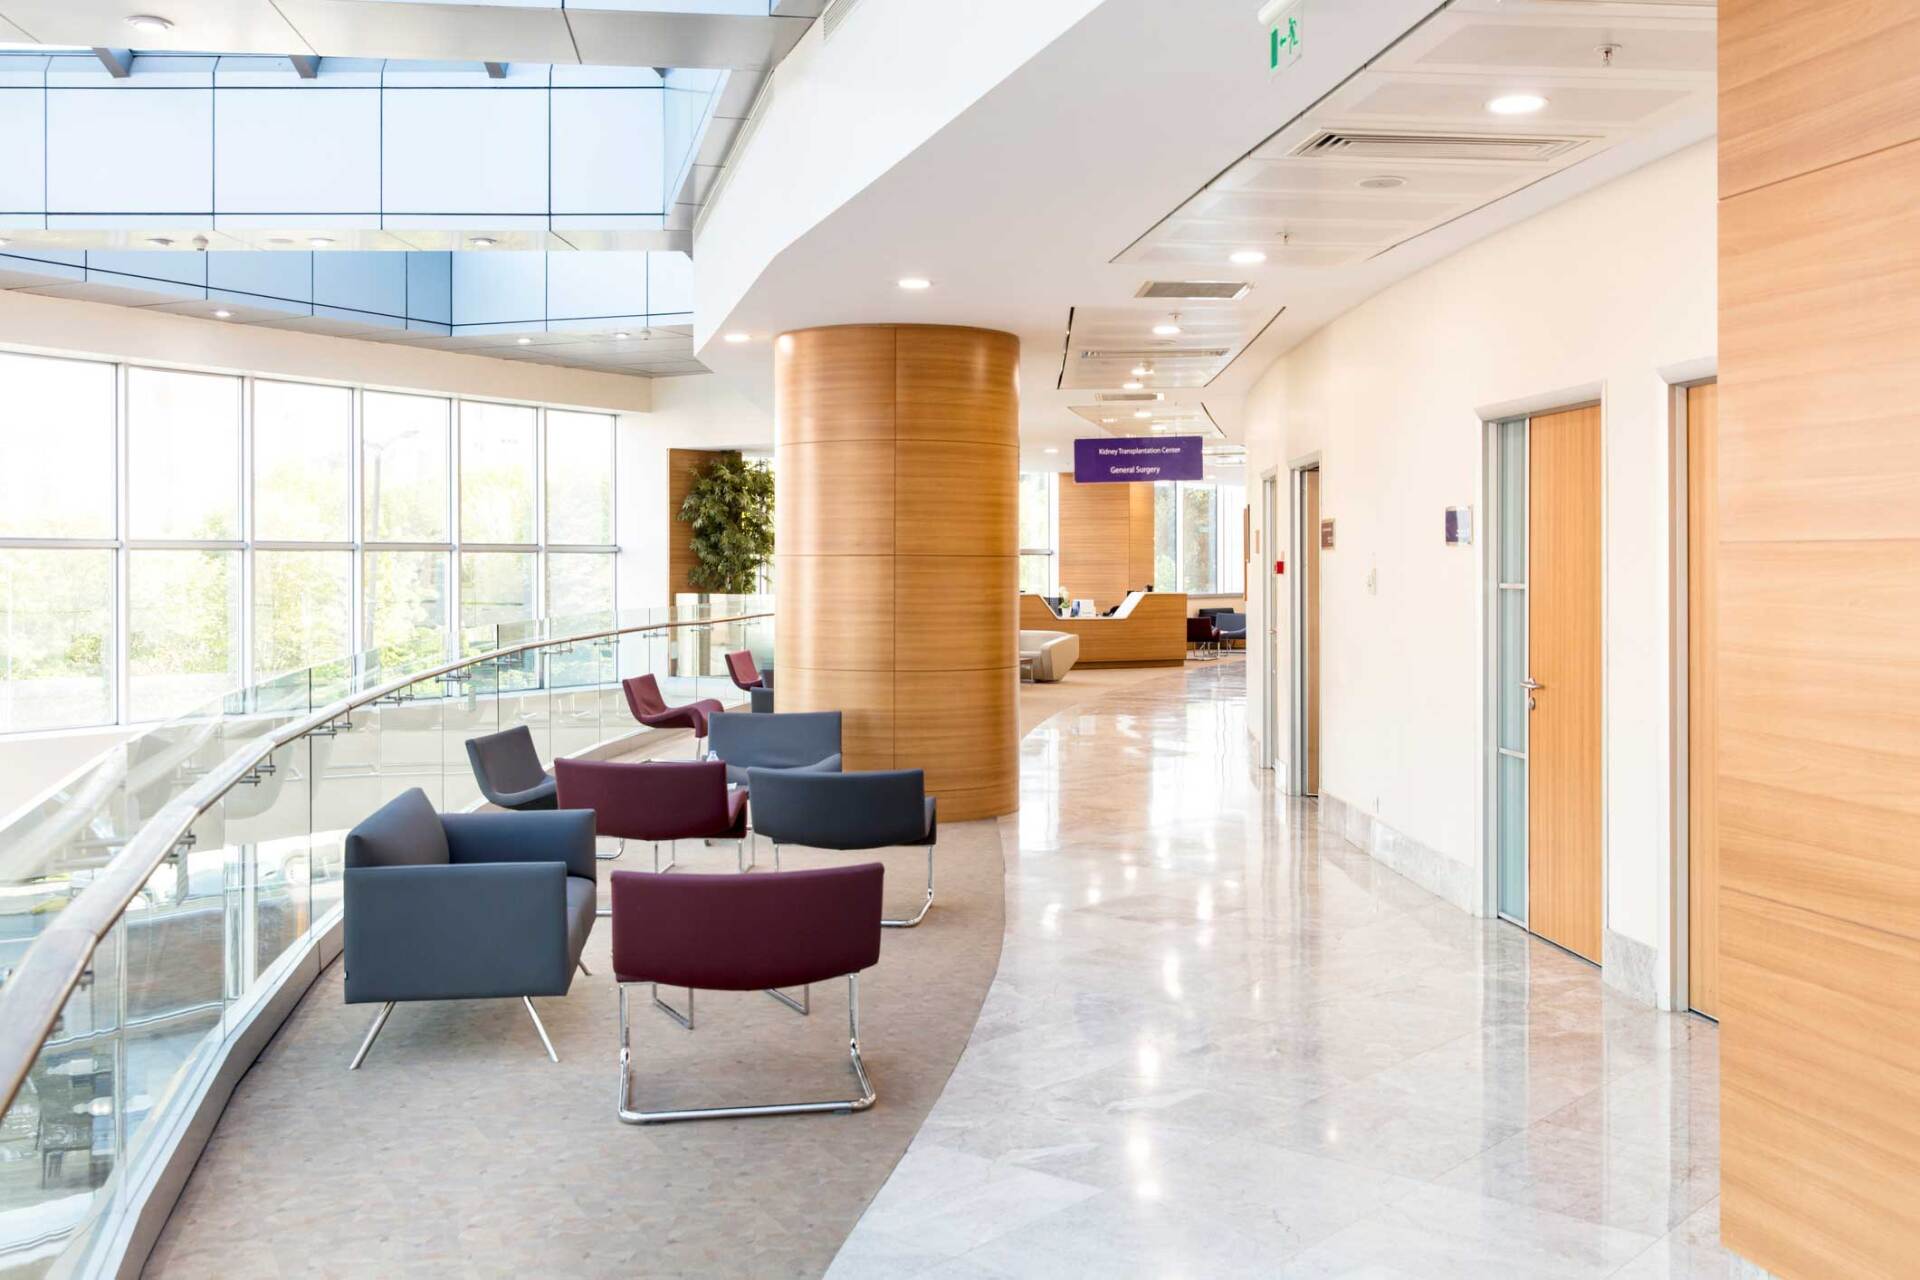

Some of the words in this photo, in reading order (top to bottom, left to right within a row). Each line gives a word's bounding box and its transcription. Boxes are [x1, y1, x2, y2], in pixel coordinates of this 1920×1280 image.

[1099, 448, 1118, 456] Kidney
[1118, 447, 1161, 455] Transplantation
[1161, 446, 1181, 454] Center
[1110, 466, 1135, 474] General
[1135, 465, 1160, 475] Surgery
